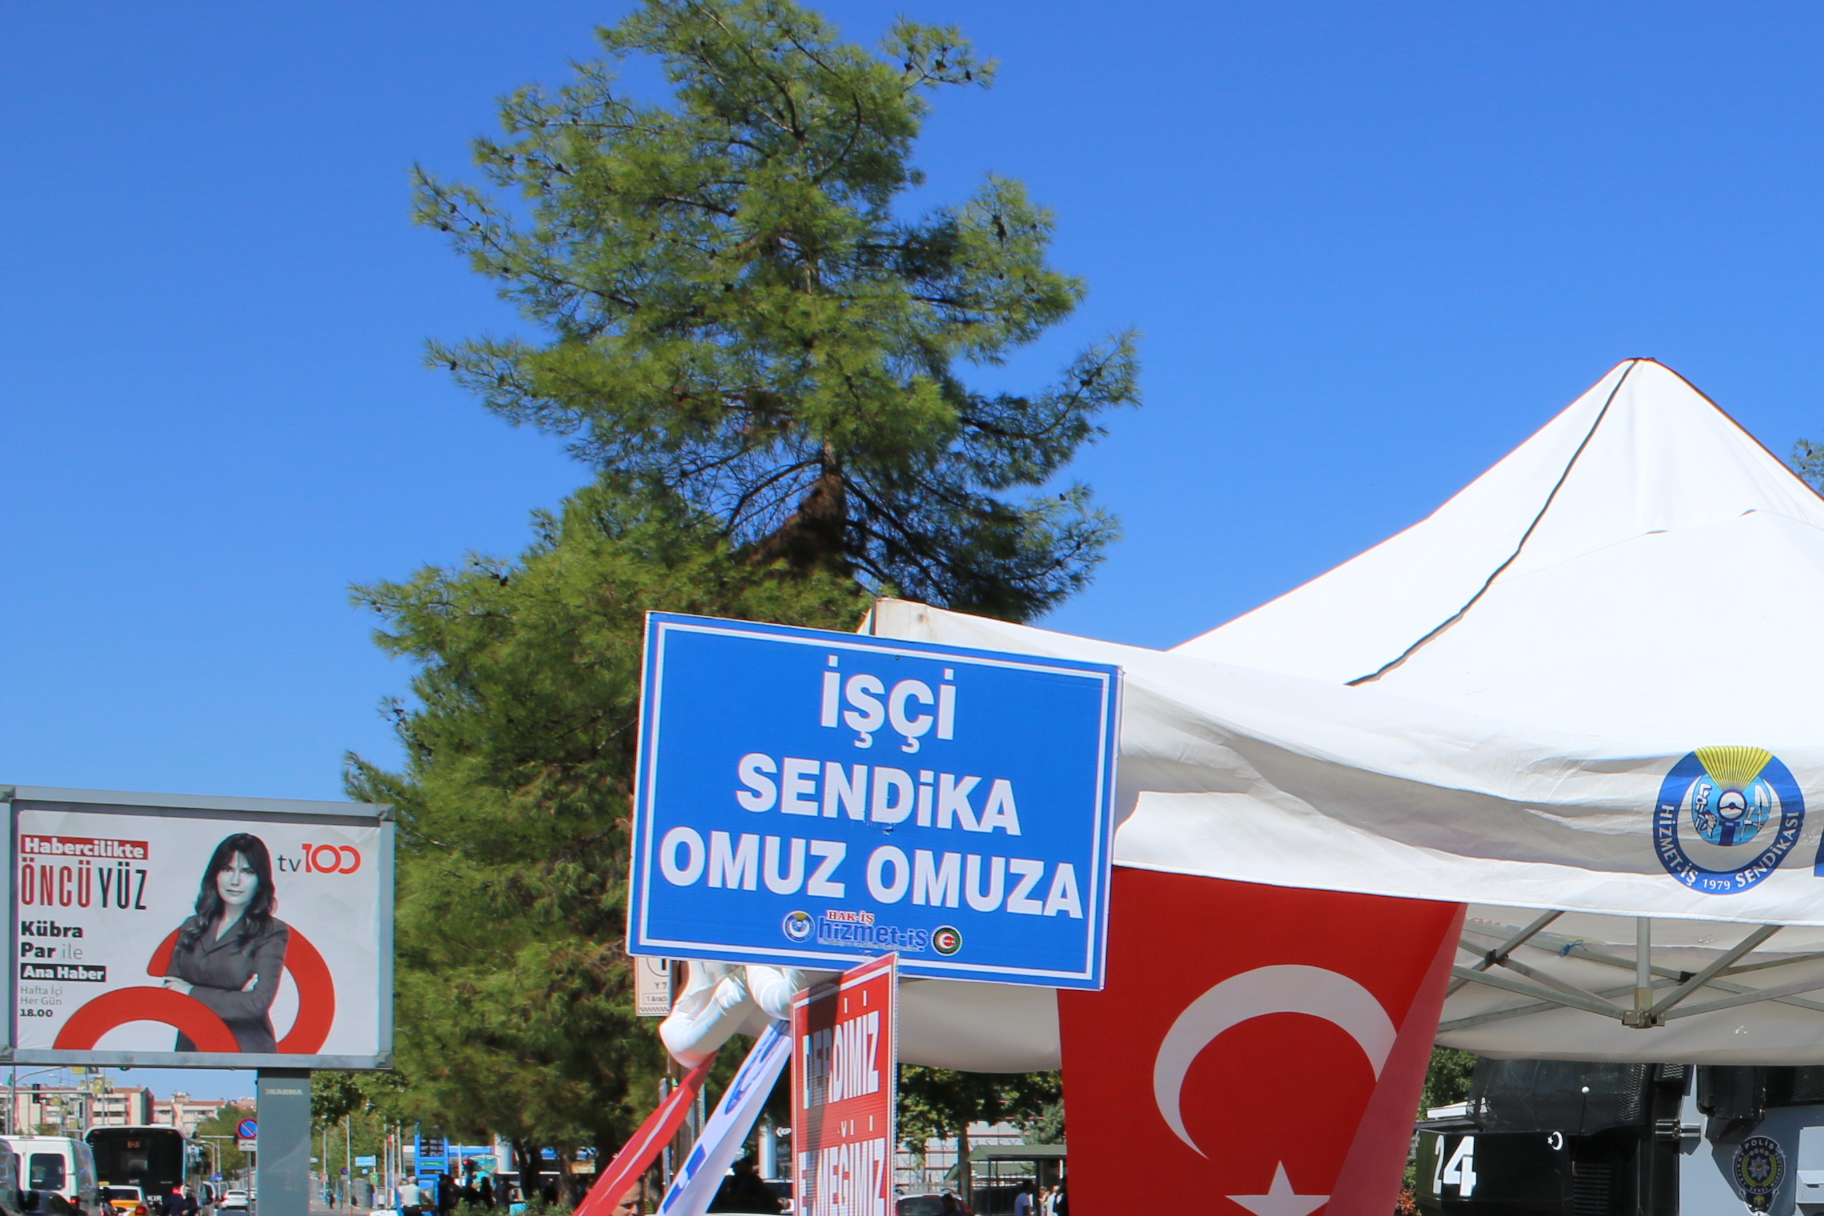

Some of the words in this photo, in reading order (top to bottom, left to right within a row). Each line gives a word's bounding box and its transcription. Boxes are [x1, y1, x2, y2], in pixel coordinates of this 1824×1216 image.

[820, 655, 957, 754] İŞÇİ
[24, 837, 145, 858] Habercilikte
[1703, 878, 1731, 890] 1979
[1735, 812, 1800, 888] SENDİKASI
[660, 826, 847, 898] OMUZ
[866, 845, 1083, 919] OMUZA
[21, 857, 91, 908] ÖNCÜ
[98, 861, 148, 910] YÜZ
[21, 920, 83, 938] Kübra
[21, 942, 56, 958] Par
[62, 943, 83, 959] ile
[23, 965, 54, 978] Ana
[57, 966, 104, 980] Haber
[20, 985, 48, 995] Hafta
[51, 984, 63, 996] İçi
[20, 997, 38, 1005] Her
[41, 996, 62, 1006] Gün
[20, 1008, 53, 1017] 18.00
[1744, 1138, 1775, 1149] POLİS
[1432, 1135, 1477, 1196] 24
